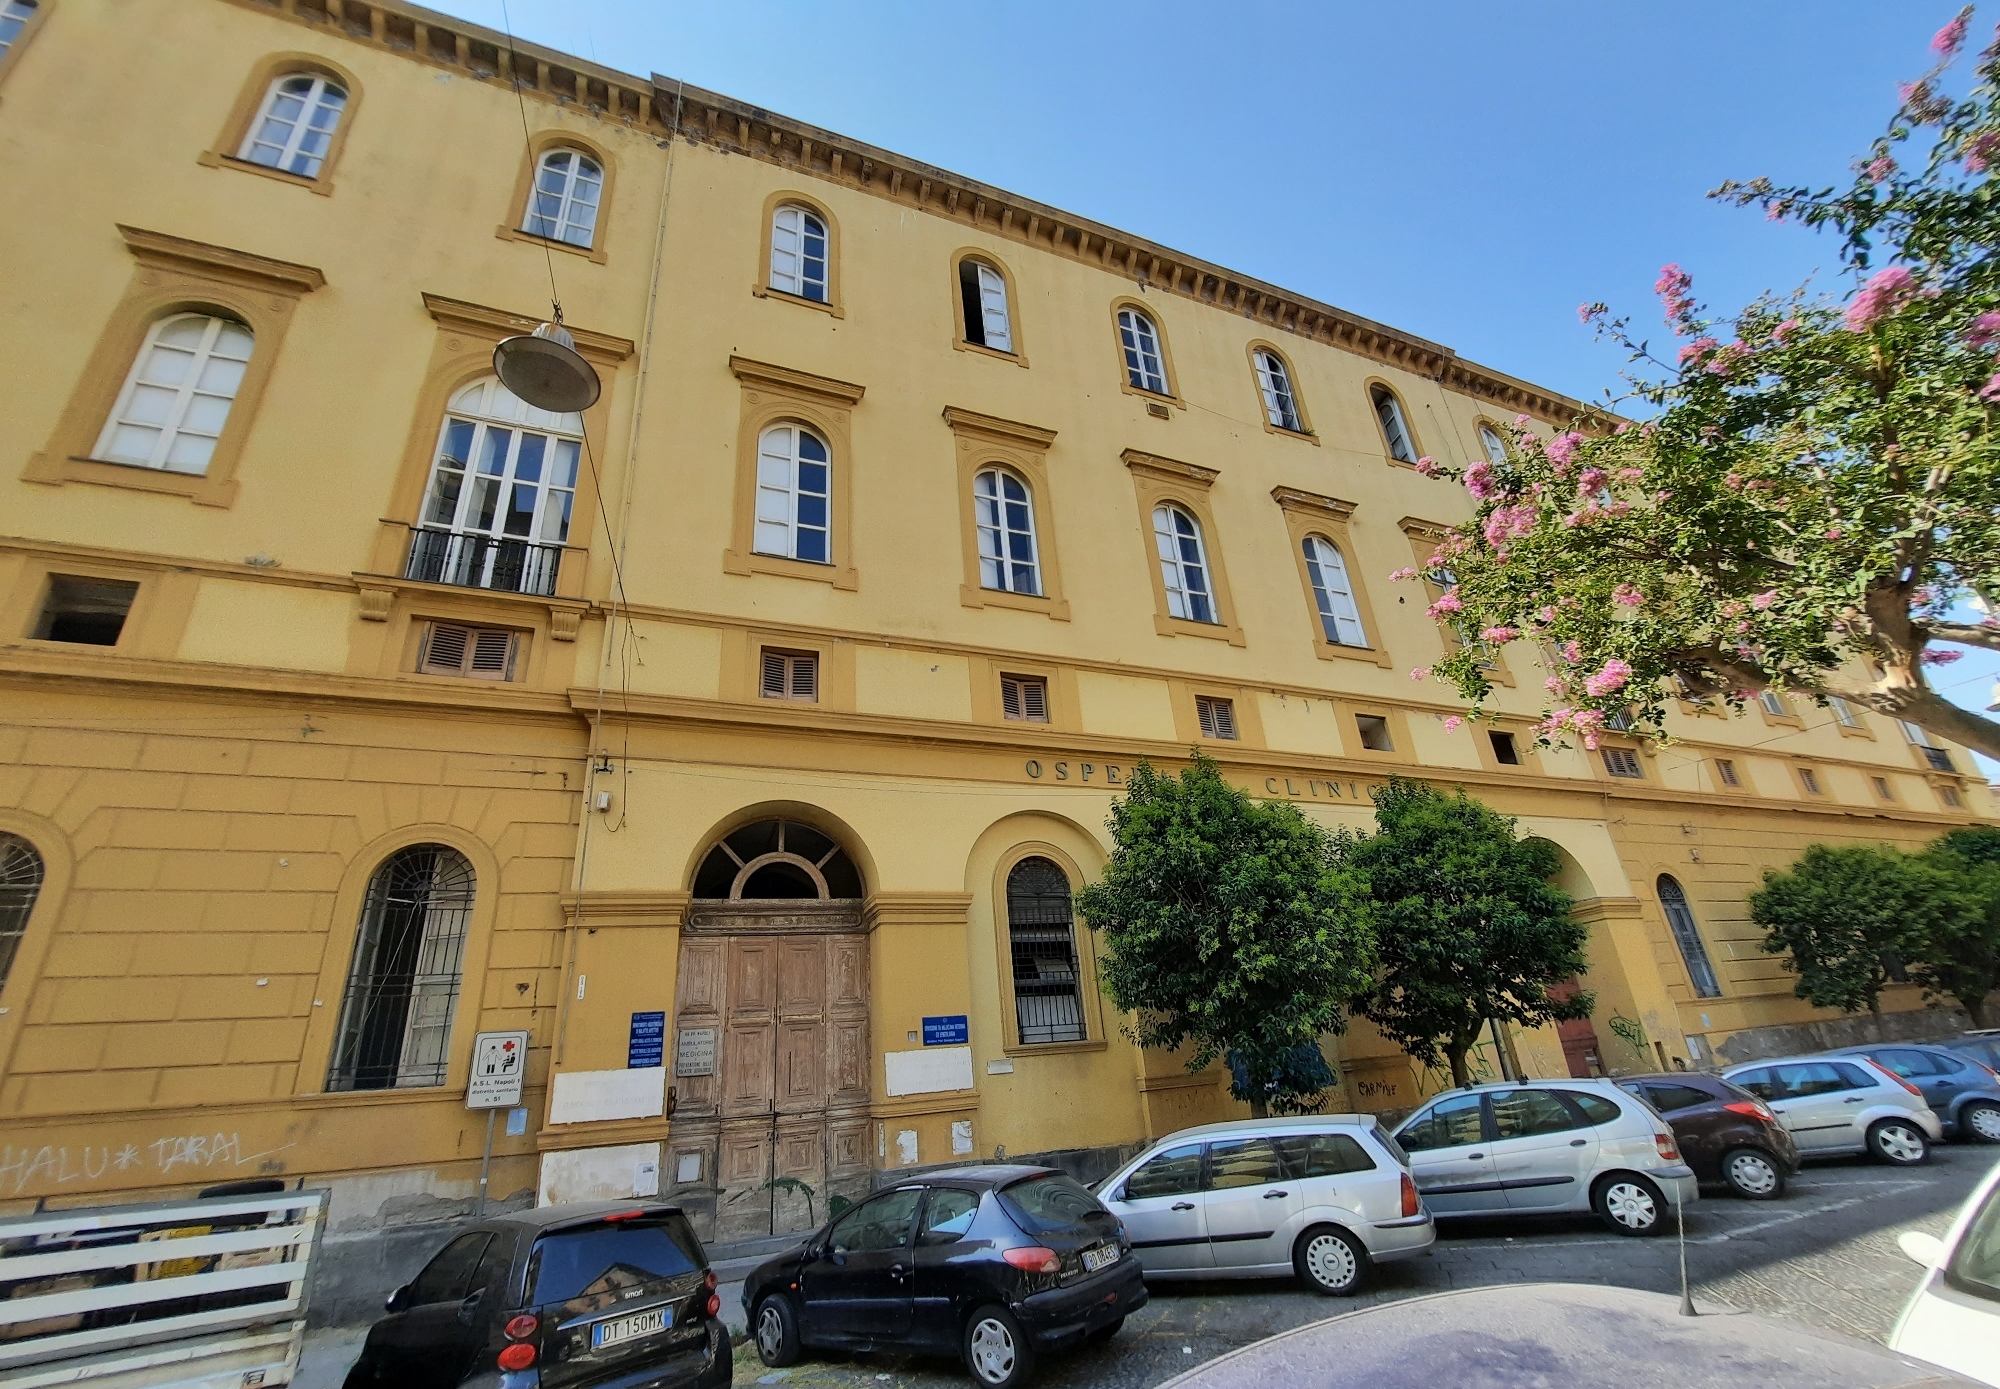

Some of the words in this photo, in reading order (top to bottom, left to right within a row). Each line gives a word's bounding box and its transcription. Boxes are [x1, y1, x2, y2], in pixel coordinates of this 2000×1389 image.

[1265, 777, 1382, 800] CLINIC
[680, 1050, 712, 1058] MEDICINA
[494, 1078, 515, 1086] Napoli
[624, 1288, 643, 1299] smart
[603, 1322, 620, 1342] DT
[625, 1310, 664, 1336] 150MX
